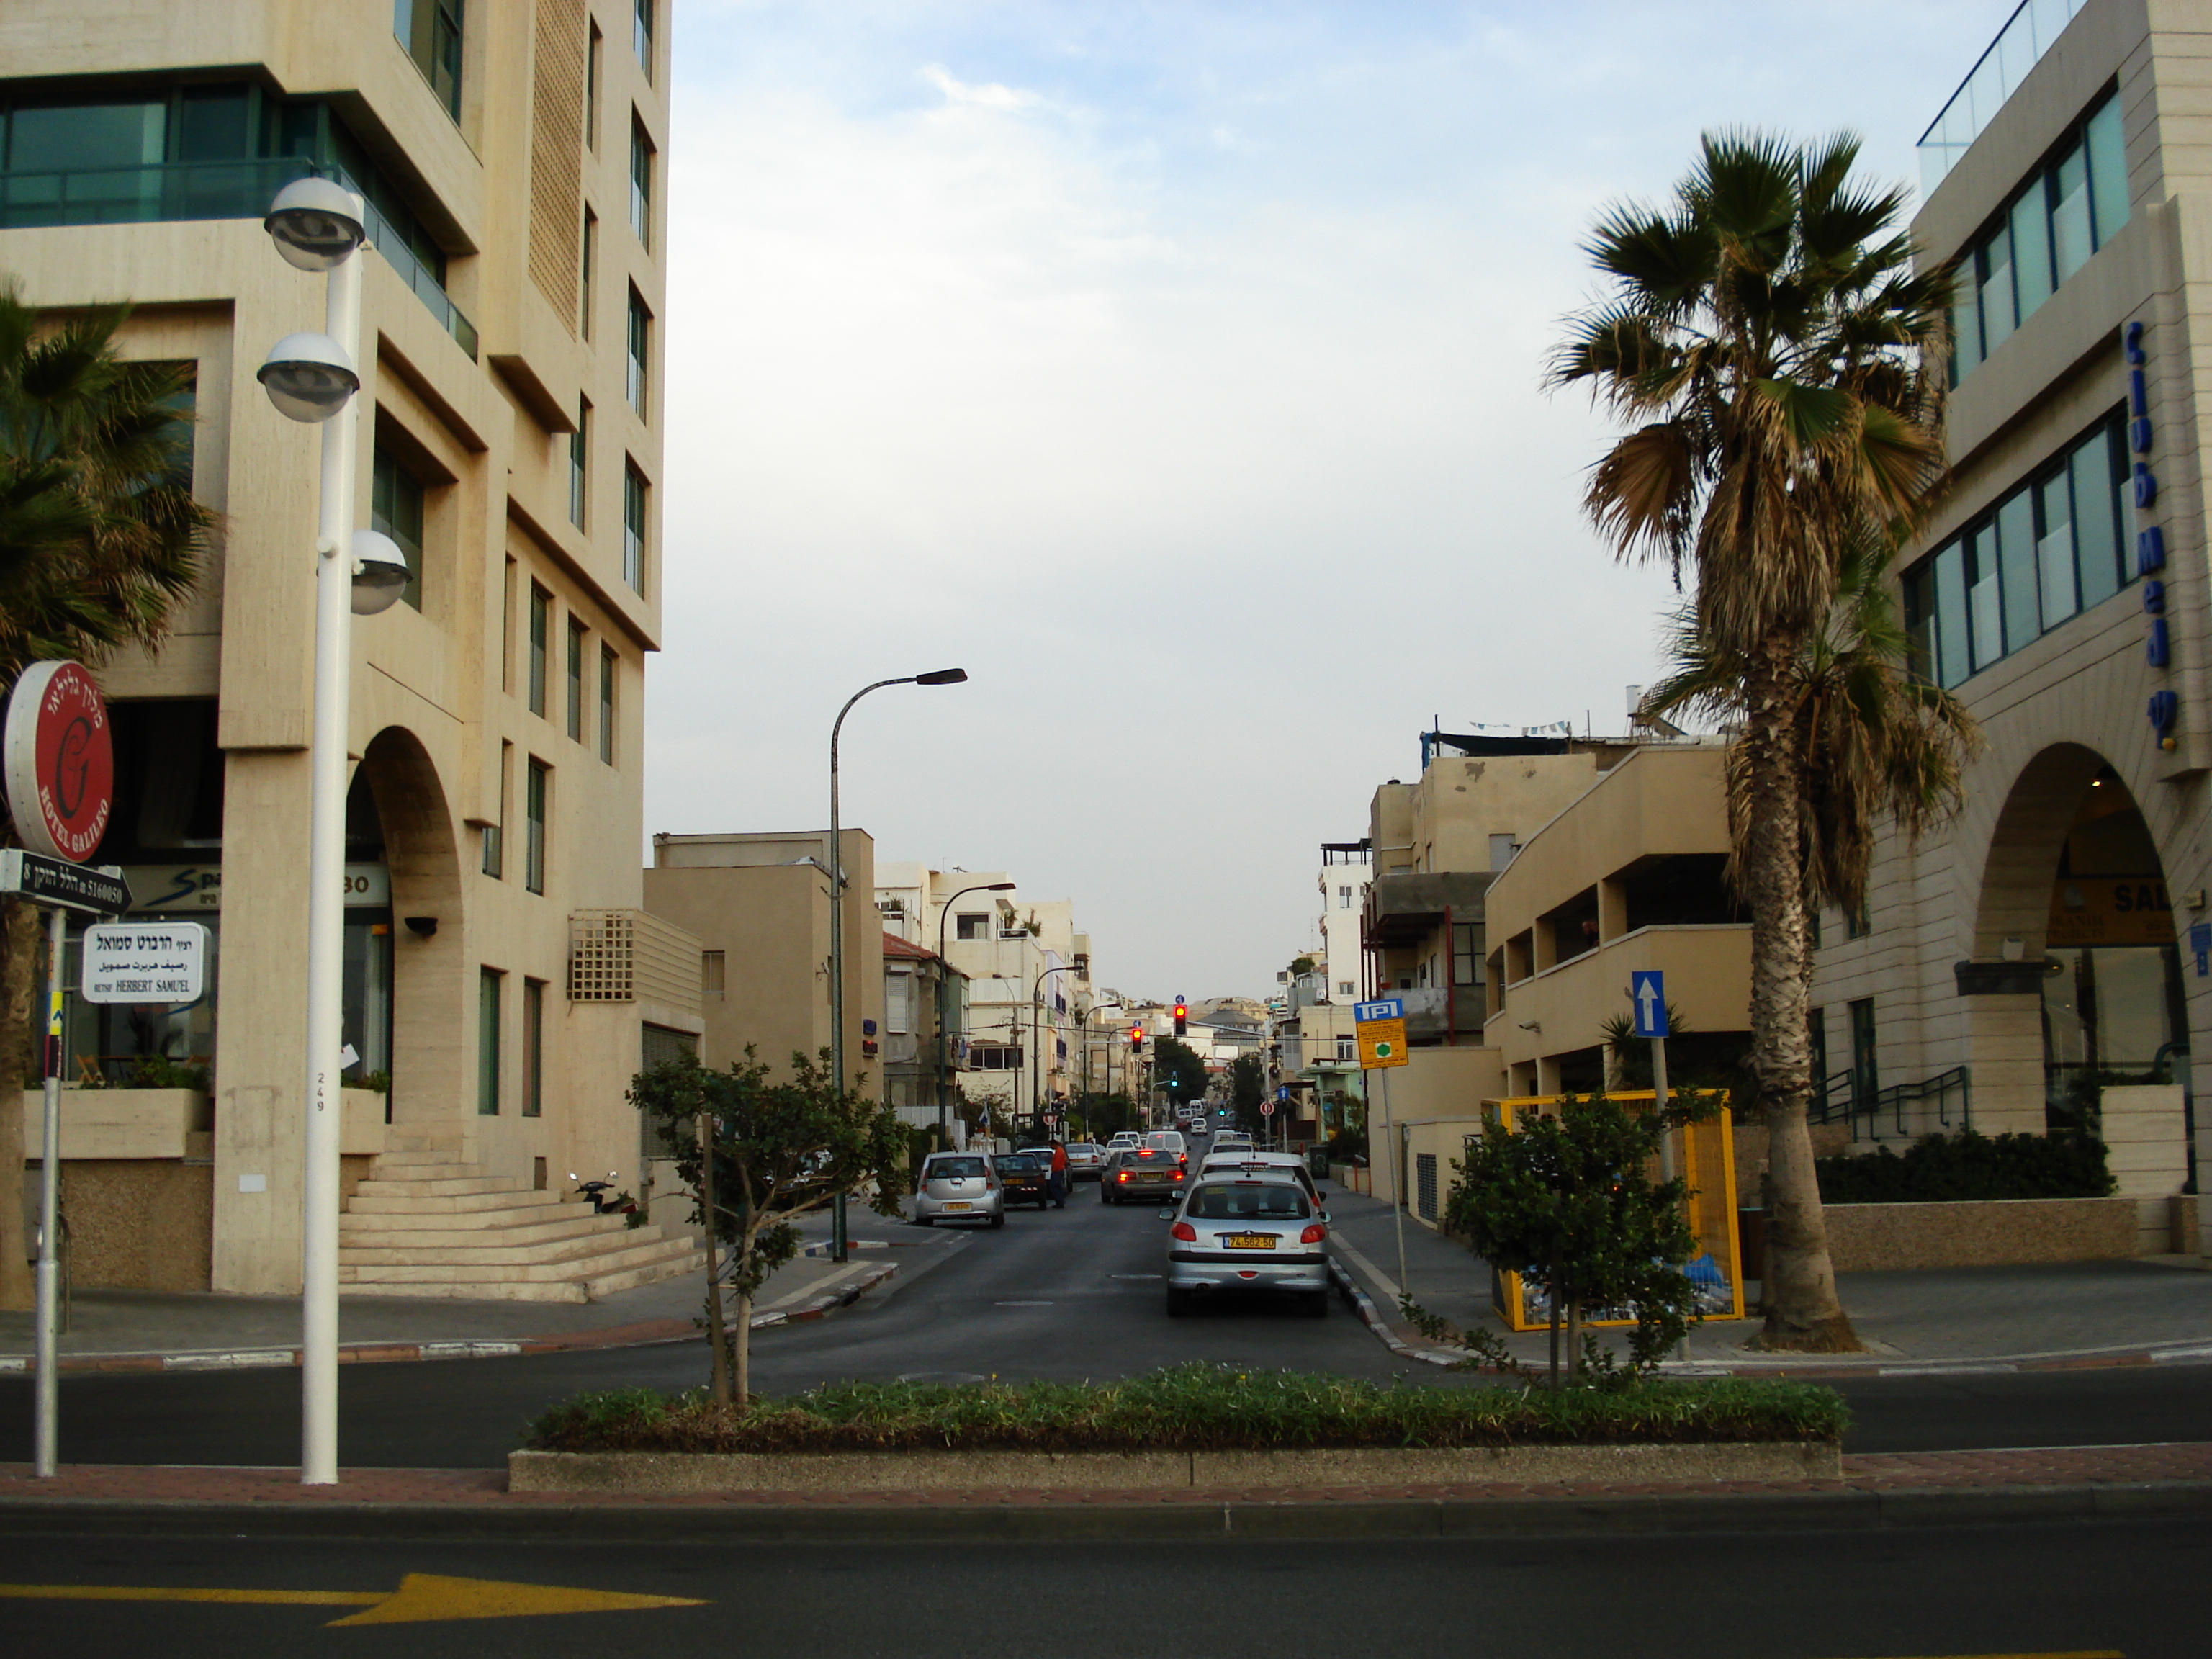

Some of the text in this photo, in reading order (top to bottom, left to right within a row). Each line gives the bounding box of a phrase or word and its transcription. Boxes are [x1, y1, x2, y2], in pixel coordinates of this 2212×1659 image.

[2126, 322, 2167, 667] Club Med
[82, 683, 104, 729] מלון
[40, 785, 109, 853] HOTEL GALILEO
[23, 862, 32, 881] 8
[87, 879, 123, 905] 5160050
[96, 932, 132, 950] סמואל
[137, 935, 173, 950] הרברט
[115, 979, 153, 992] HERBERT
